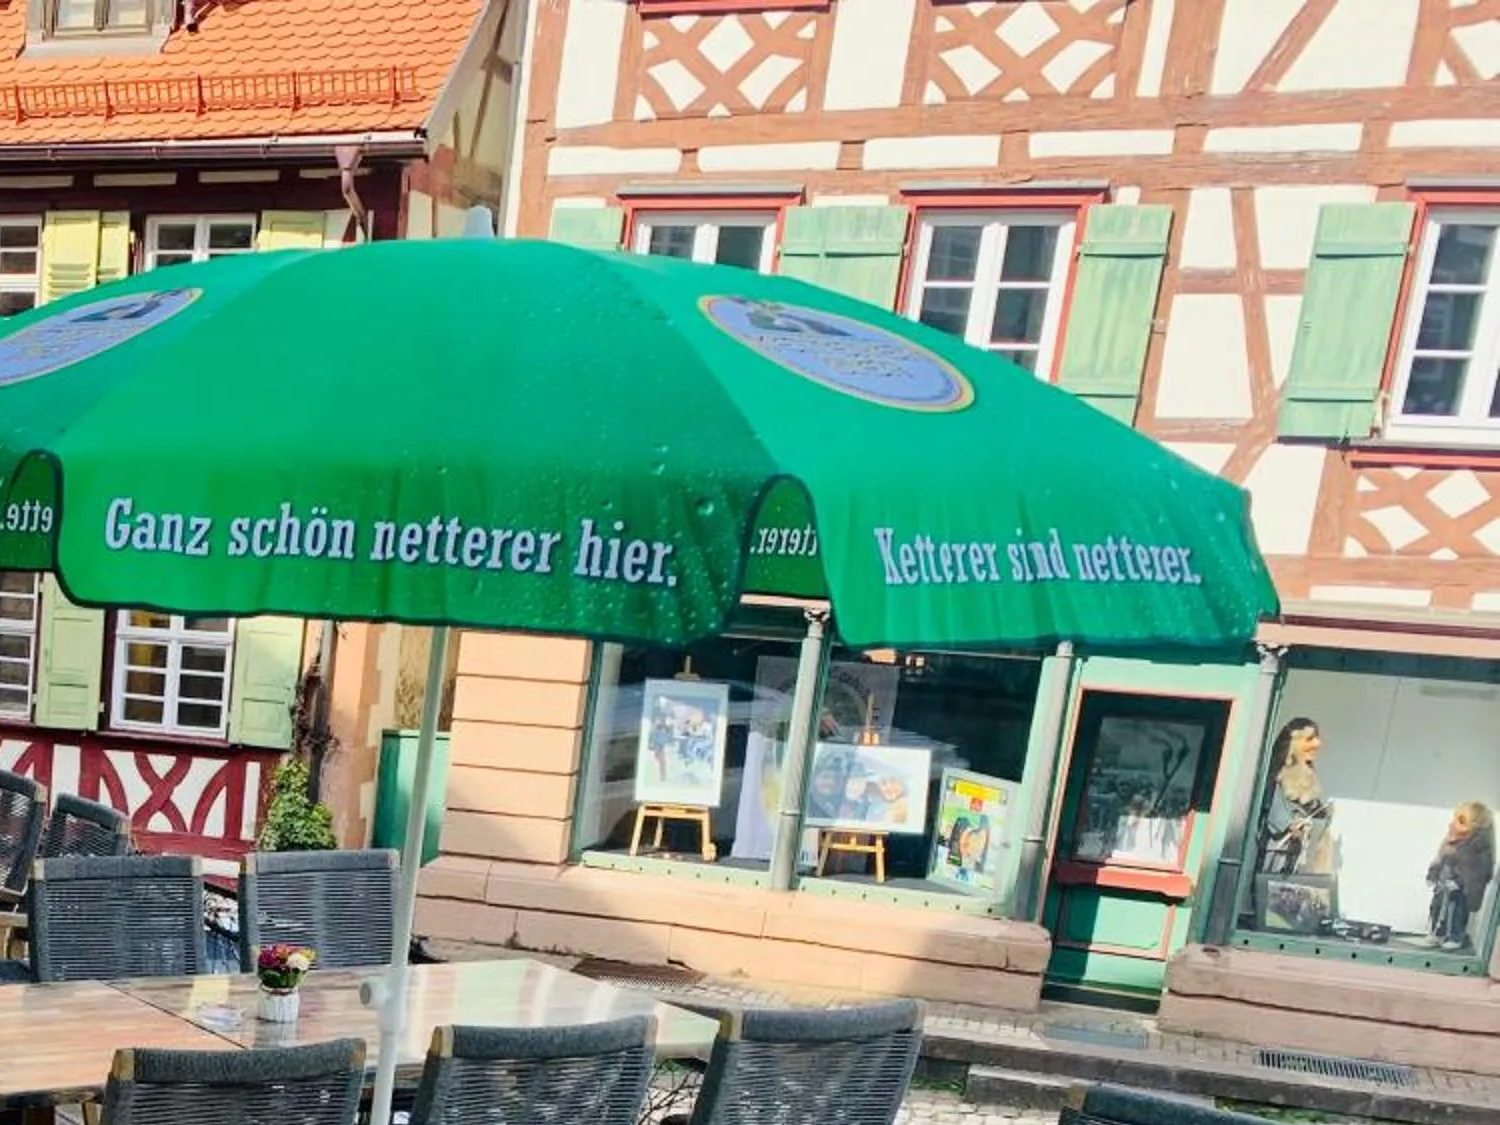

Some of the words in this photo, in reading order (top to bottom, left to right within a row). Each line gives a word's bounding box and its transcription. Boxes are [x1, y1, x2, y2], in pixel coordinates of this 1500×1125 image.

[104, 497, 213, 556] Ganz
[227, 502, 356, 560] schön
[369, 515, 561, 574] netterer
[574, 518, 678, 588] hier.
[873, 527, 1001, 585] Ketterer
[1007, 527, 1070, 582] sind
[1072, 535, 1202, 585] netterer.
